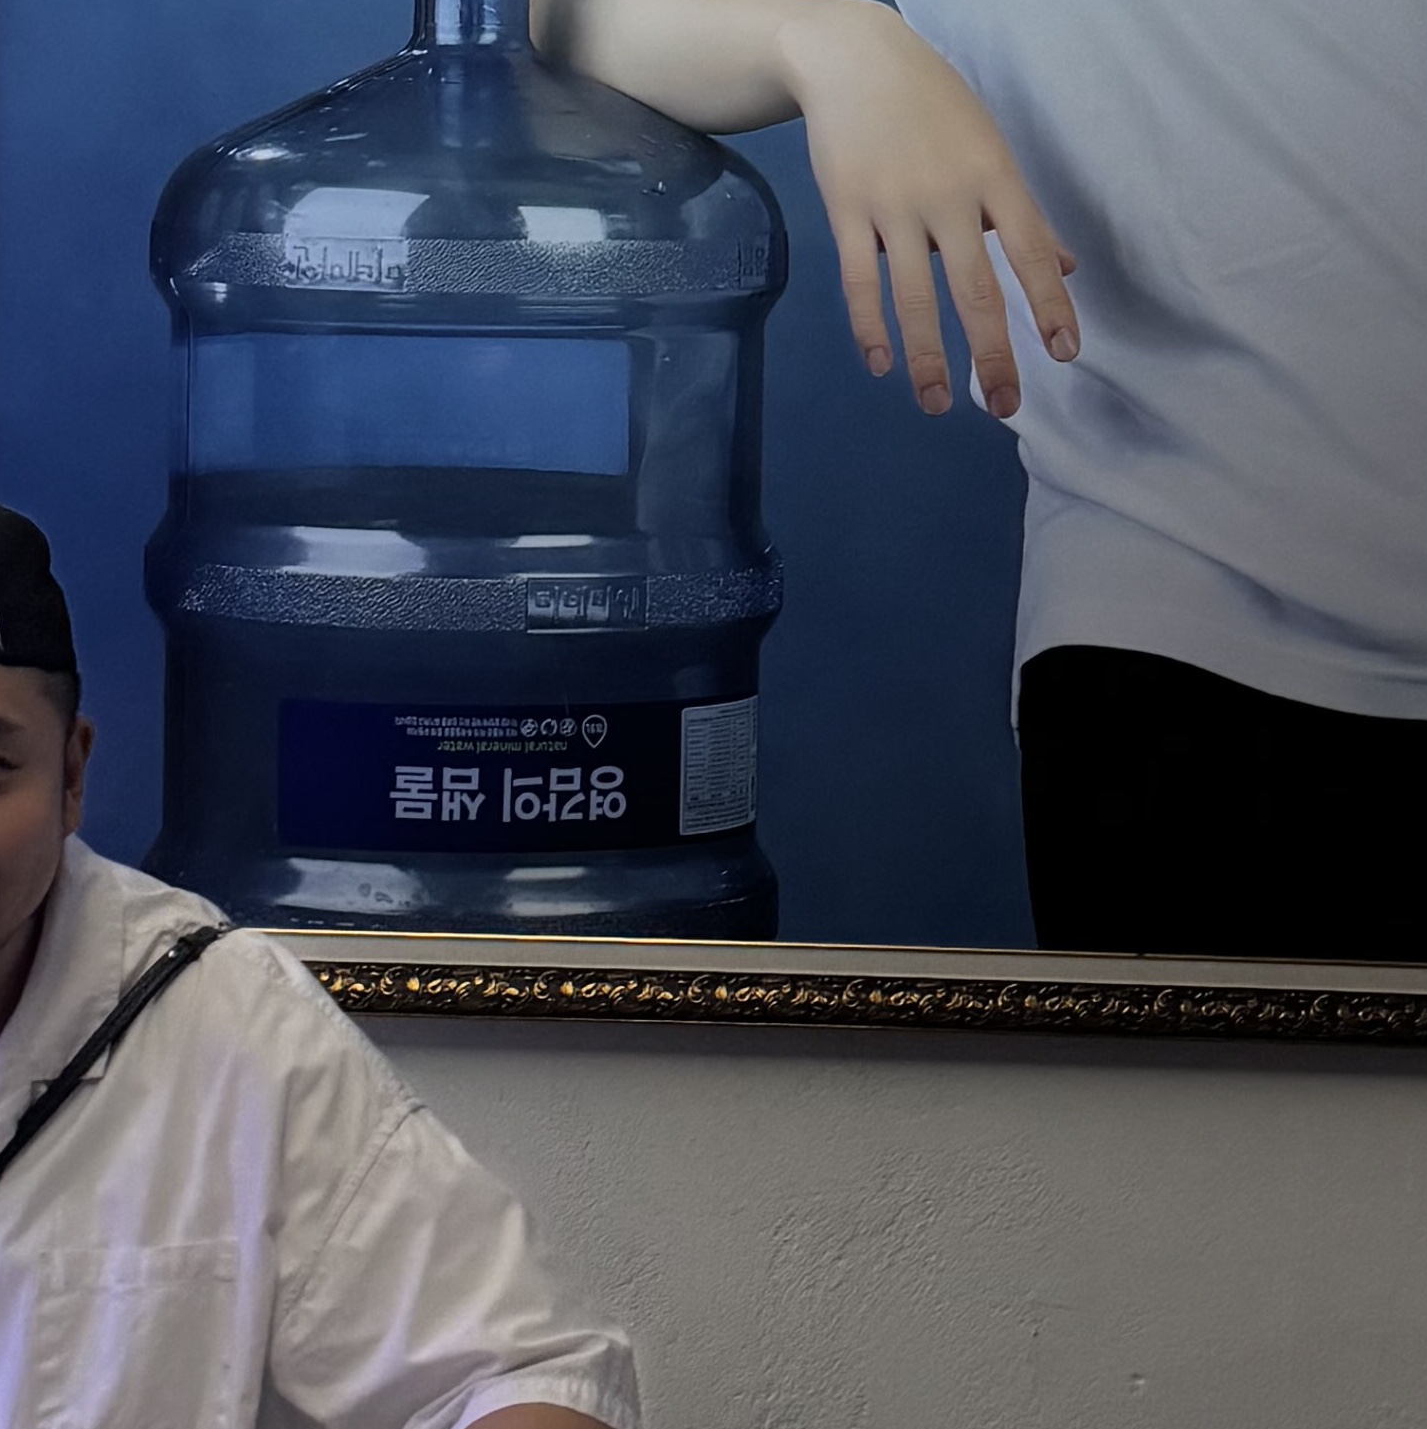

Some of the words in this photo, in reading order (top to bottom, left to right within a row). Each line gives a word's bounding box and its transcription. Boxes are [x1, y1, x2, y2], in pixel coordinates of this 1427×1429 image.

[437, 741, 474, 752] water
[477, 741, 522, 754] mineral
[525, 741, 568, 754] natural
[389, 765, 486, 822] 샘물
[502, 765, 627, 823] 영감의
